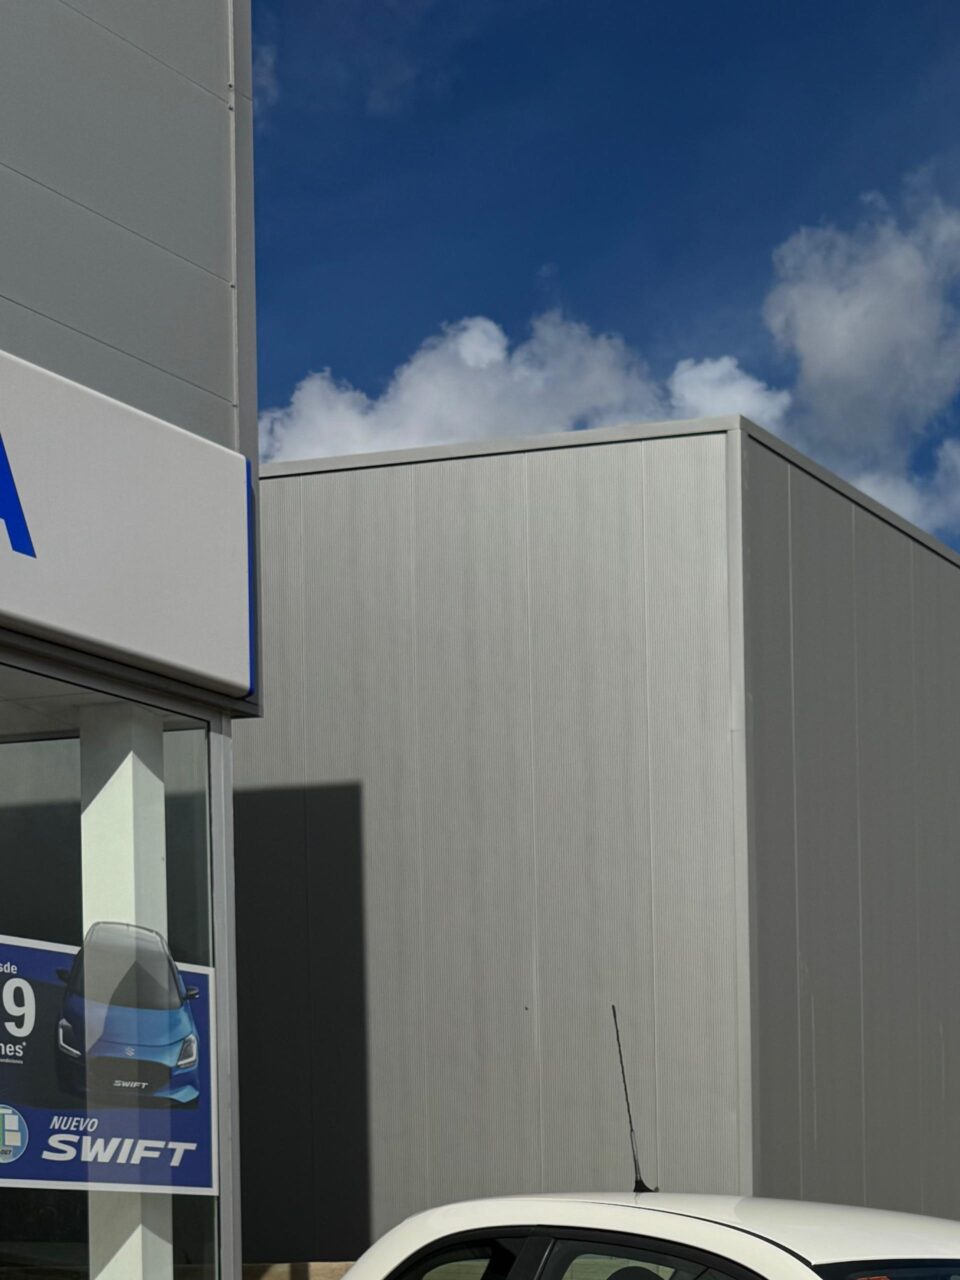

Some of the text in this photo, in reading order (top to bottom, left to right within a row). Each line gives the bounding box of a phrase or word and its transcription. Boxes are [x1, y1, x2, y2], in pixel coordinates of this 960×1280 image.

[113, 1080, 149, 1089] SWIFT
[50, 1116, 99, 1132] NUEVO
[41, 1133, 198, 1167] SWIFT
